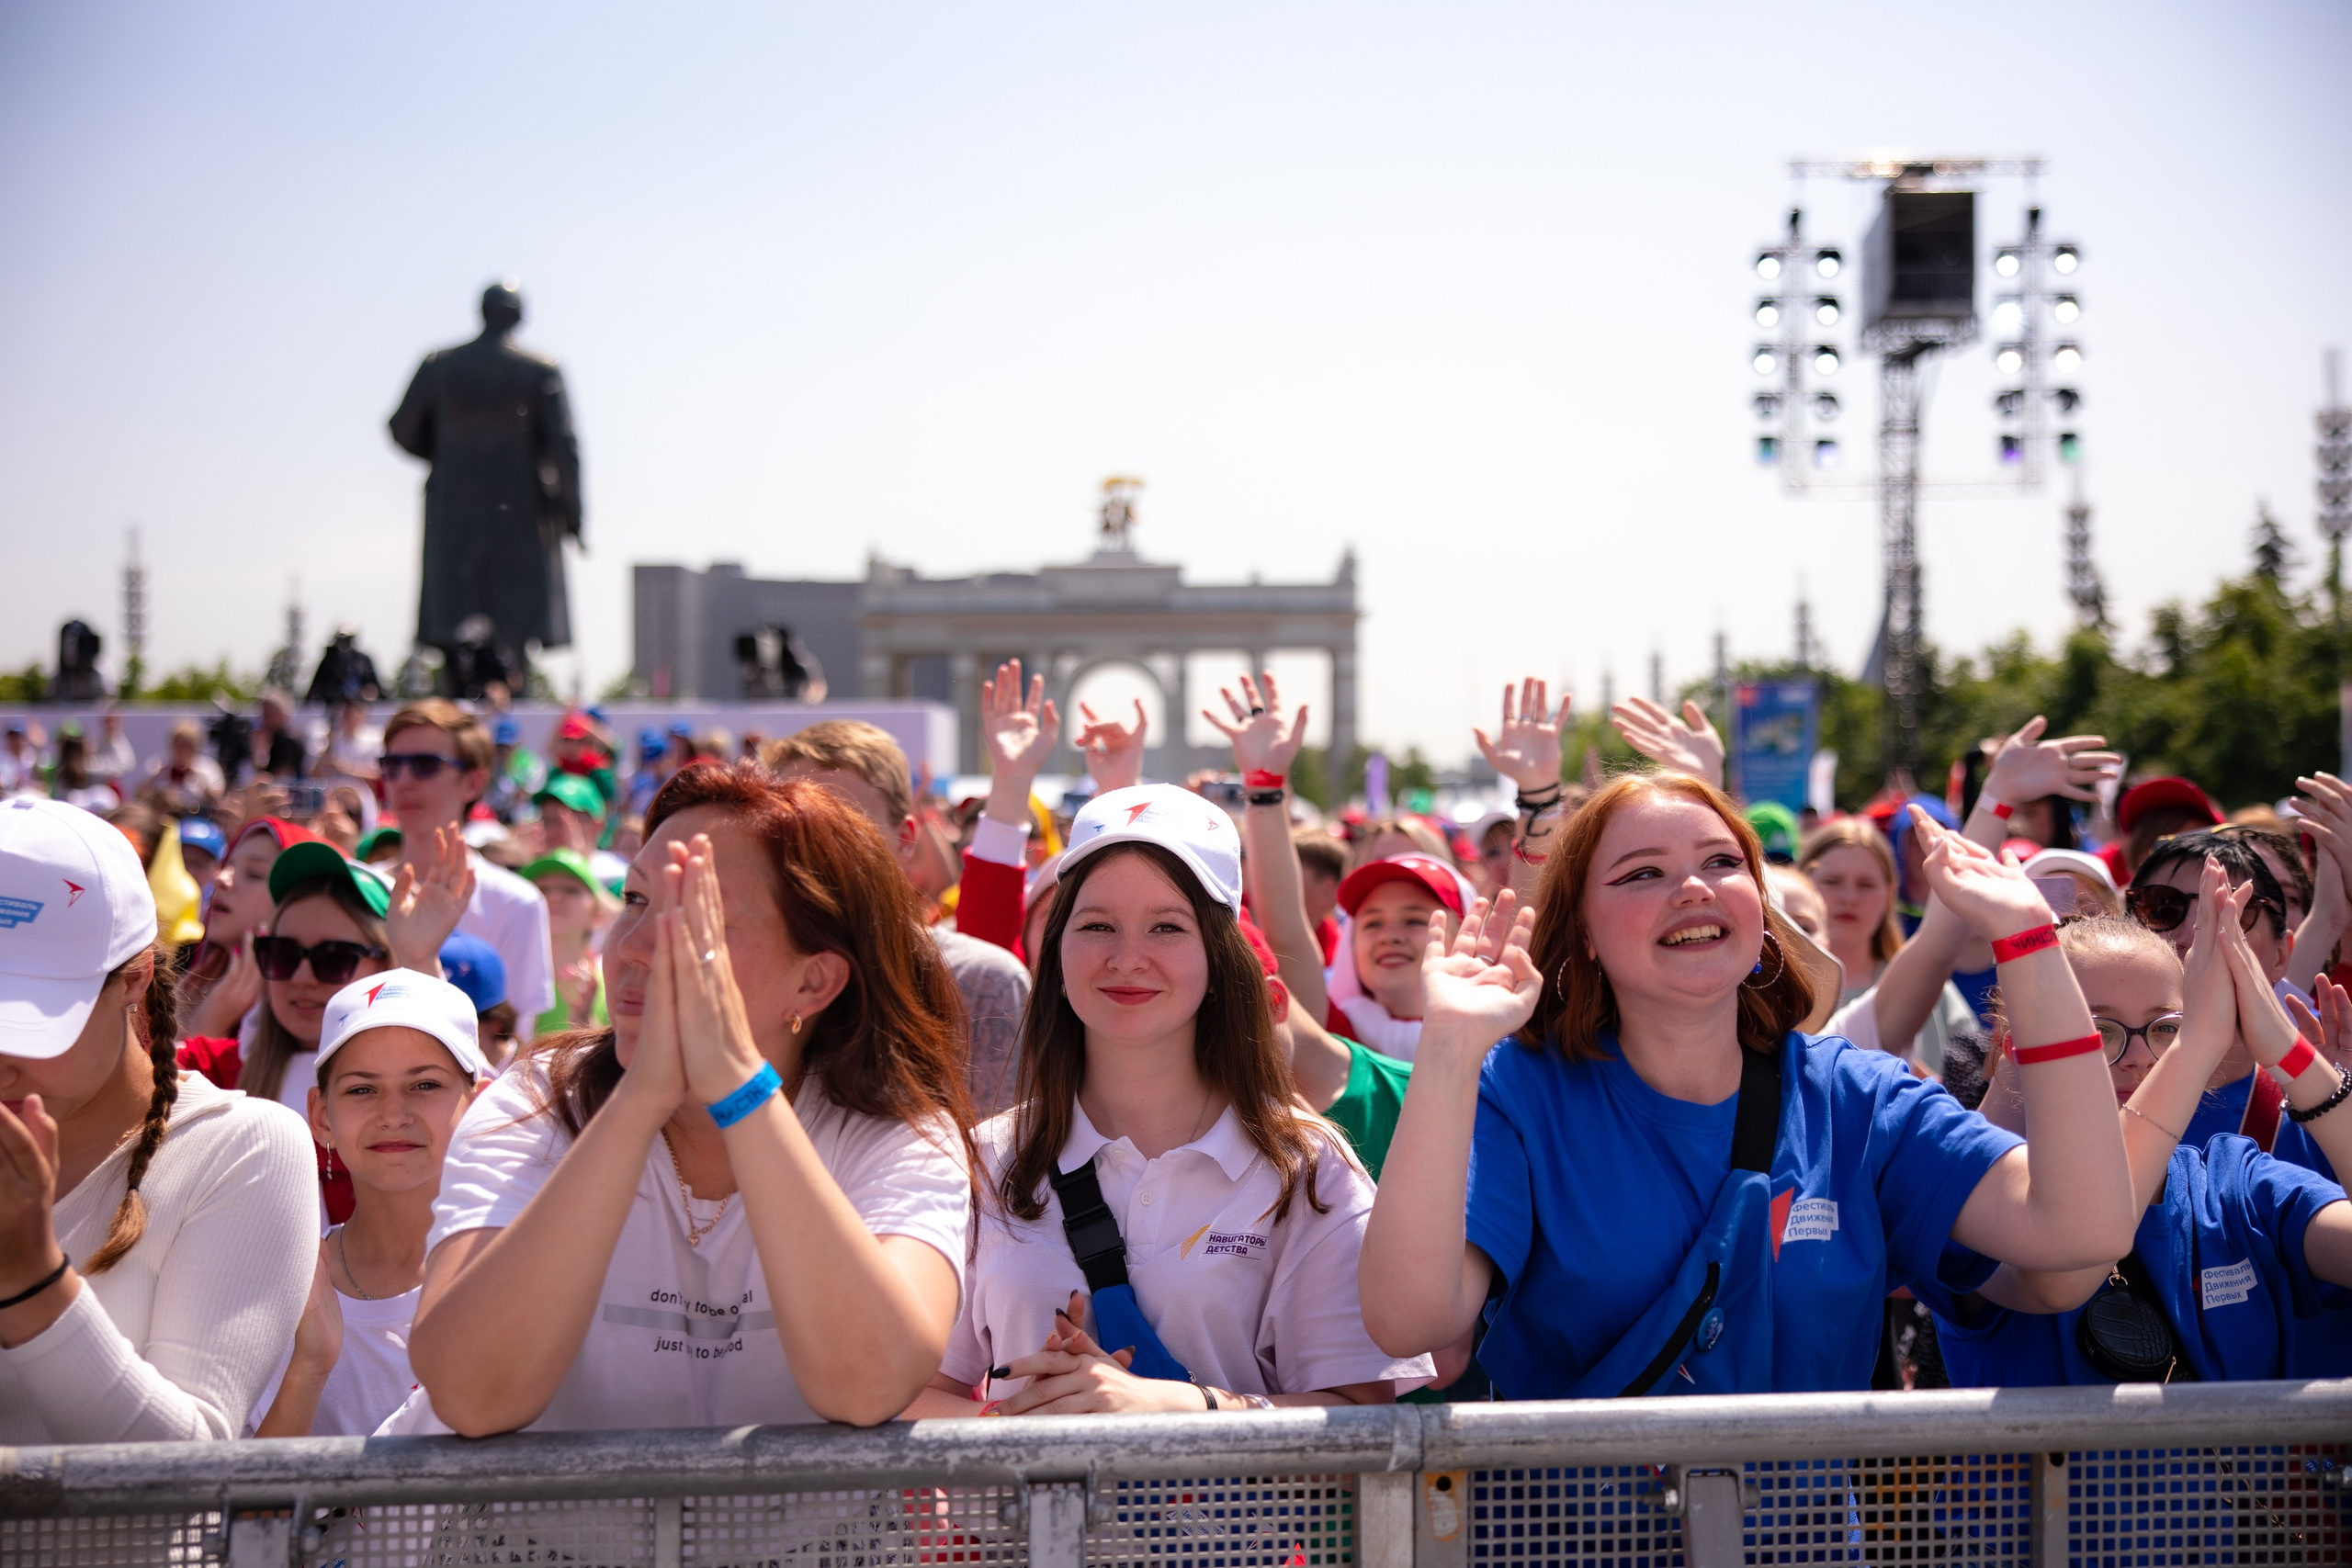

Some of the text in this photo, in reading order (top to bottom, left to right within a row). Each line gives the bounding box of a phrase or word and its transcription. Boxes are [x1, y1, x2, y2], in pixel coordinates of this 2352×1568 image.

[1790, 1214, 1834, 1226] Движения
[1788, 1227, 1828, 1237] Первых
[1208, 1234, 1268, 1247] НАВИГАТОРЫ
[1205, 1245, 1248, 1256] ДЕТСТВА
[2203, 1263, 2251, 1280] Фестиваль
[2204, 1275, 2252, 1293] Движения
[2204, 1292, 2243, 1304] Первых
[695, 1301, 708, 1314] to
[708, 1306, 726, 1317] be
[653, 1337, 684, 1352] just
[695, 1347, 709, 1359] to
